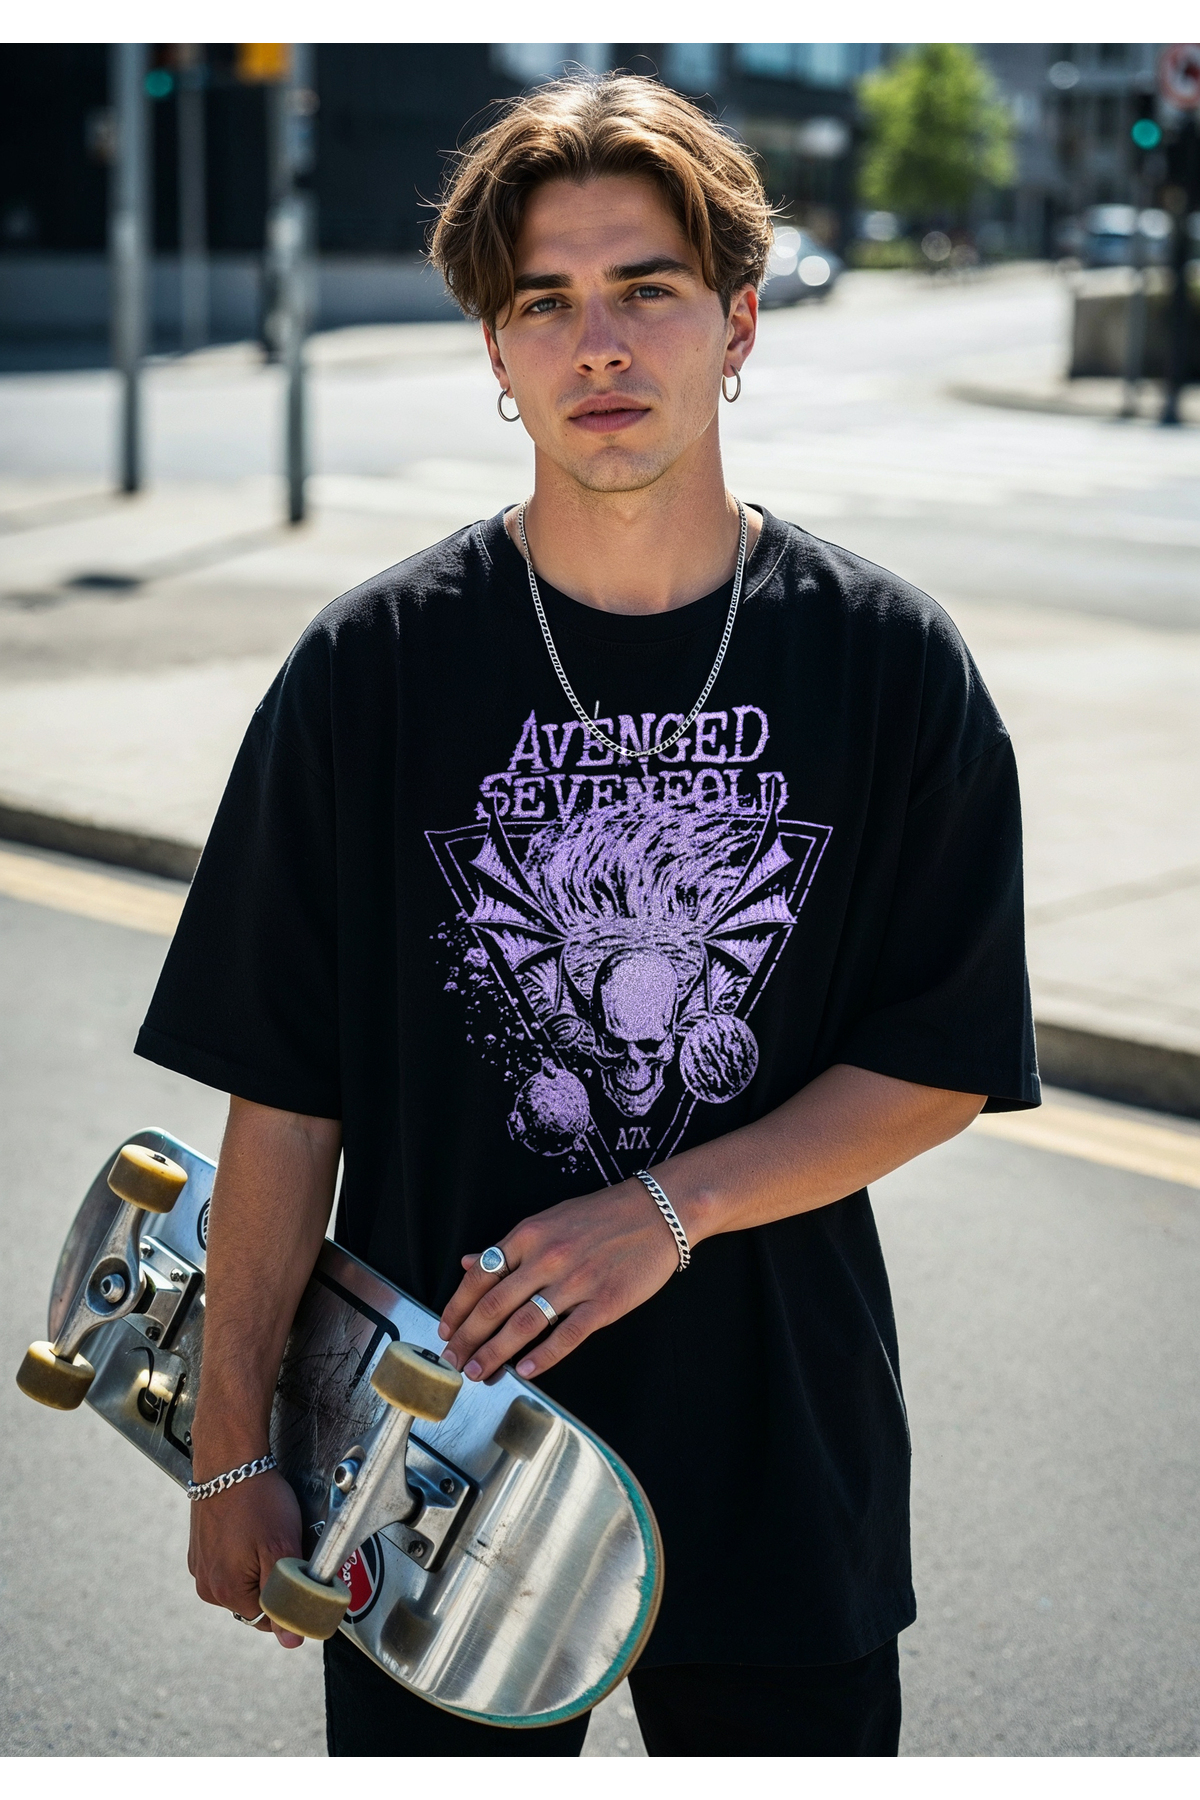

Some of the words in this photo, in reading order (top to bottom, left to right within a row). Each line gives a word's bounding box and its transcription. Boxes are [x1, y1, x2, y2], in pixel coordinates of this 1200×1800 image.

[507, 705, 769, 772] AVENGED
[476, 768, 789, 821] SEVENFOLD
[616, 1126, 651, 1150] A7X
